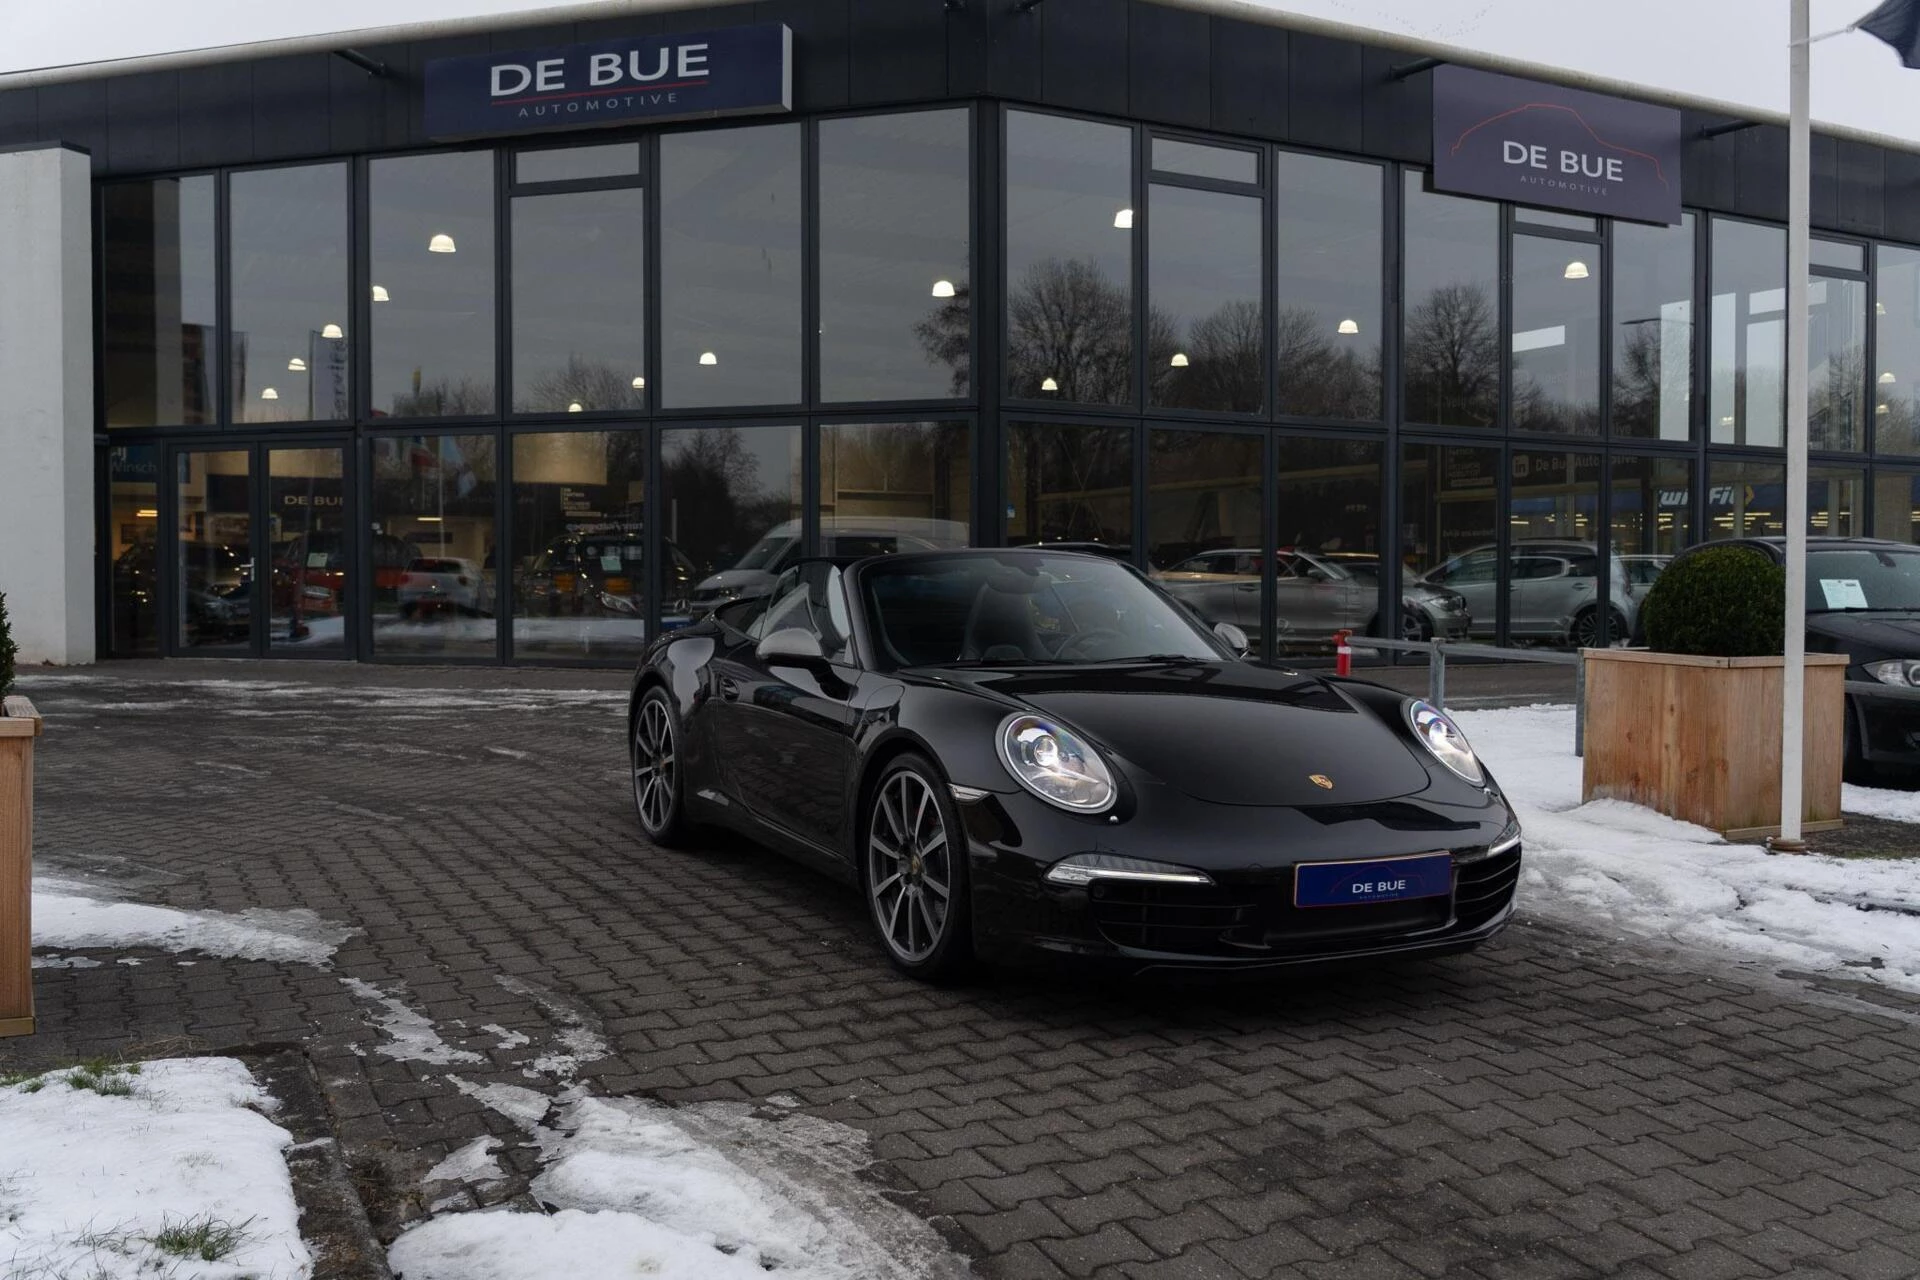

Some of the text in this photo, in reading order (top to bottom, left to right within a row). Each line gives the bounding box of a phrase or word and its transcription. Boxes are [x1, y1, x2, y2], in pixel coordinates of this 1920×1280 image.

[491, 44, 709, 96] DE BUE
[519, 93, 677, 117] AUTOMOTIVE
[1503, 140, 1624, 182] DE BUE
[1521, 175, 1607, 196] AUTOMOTIVE
[1552, 456, 1568, 471] Bu
[284, 495, 309, 505] DE
[1352, 880, 1406, 893] DE BUE
